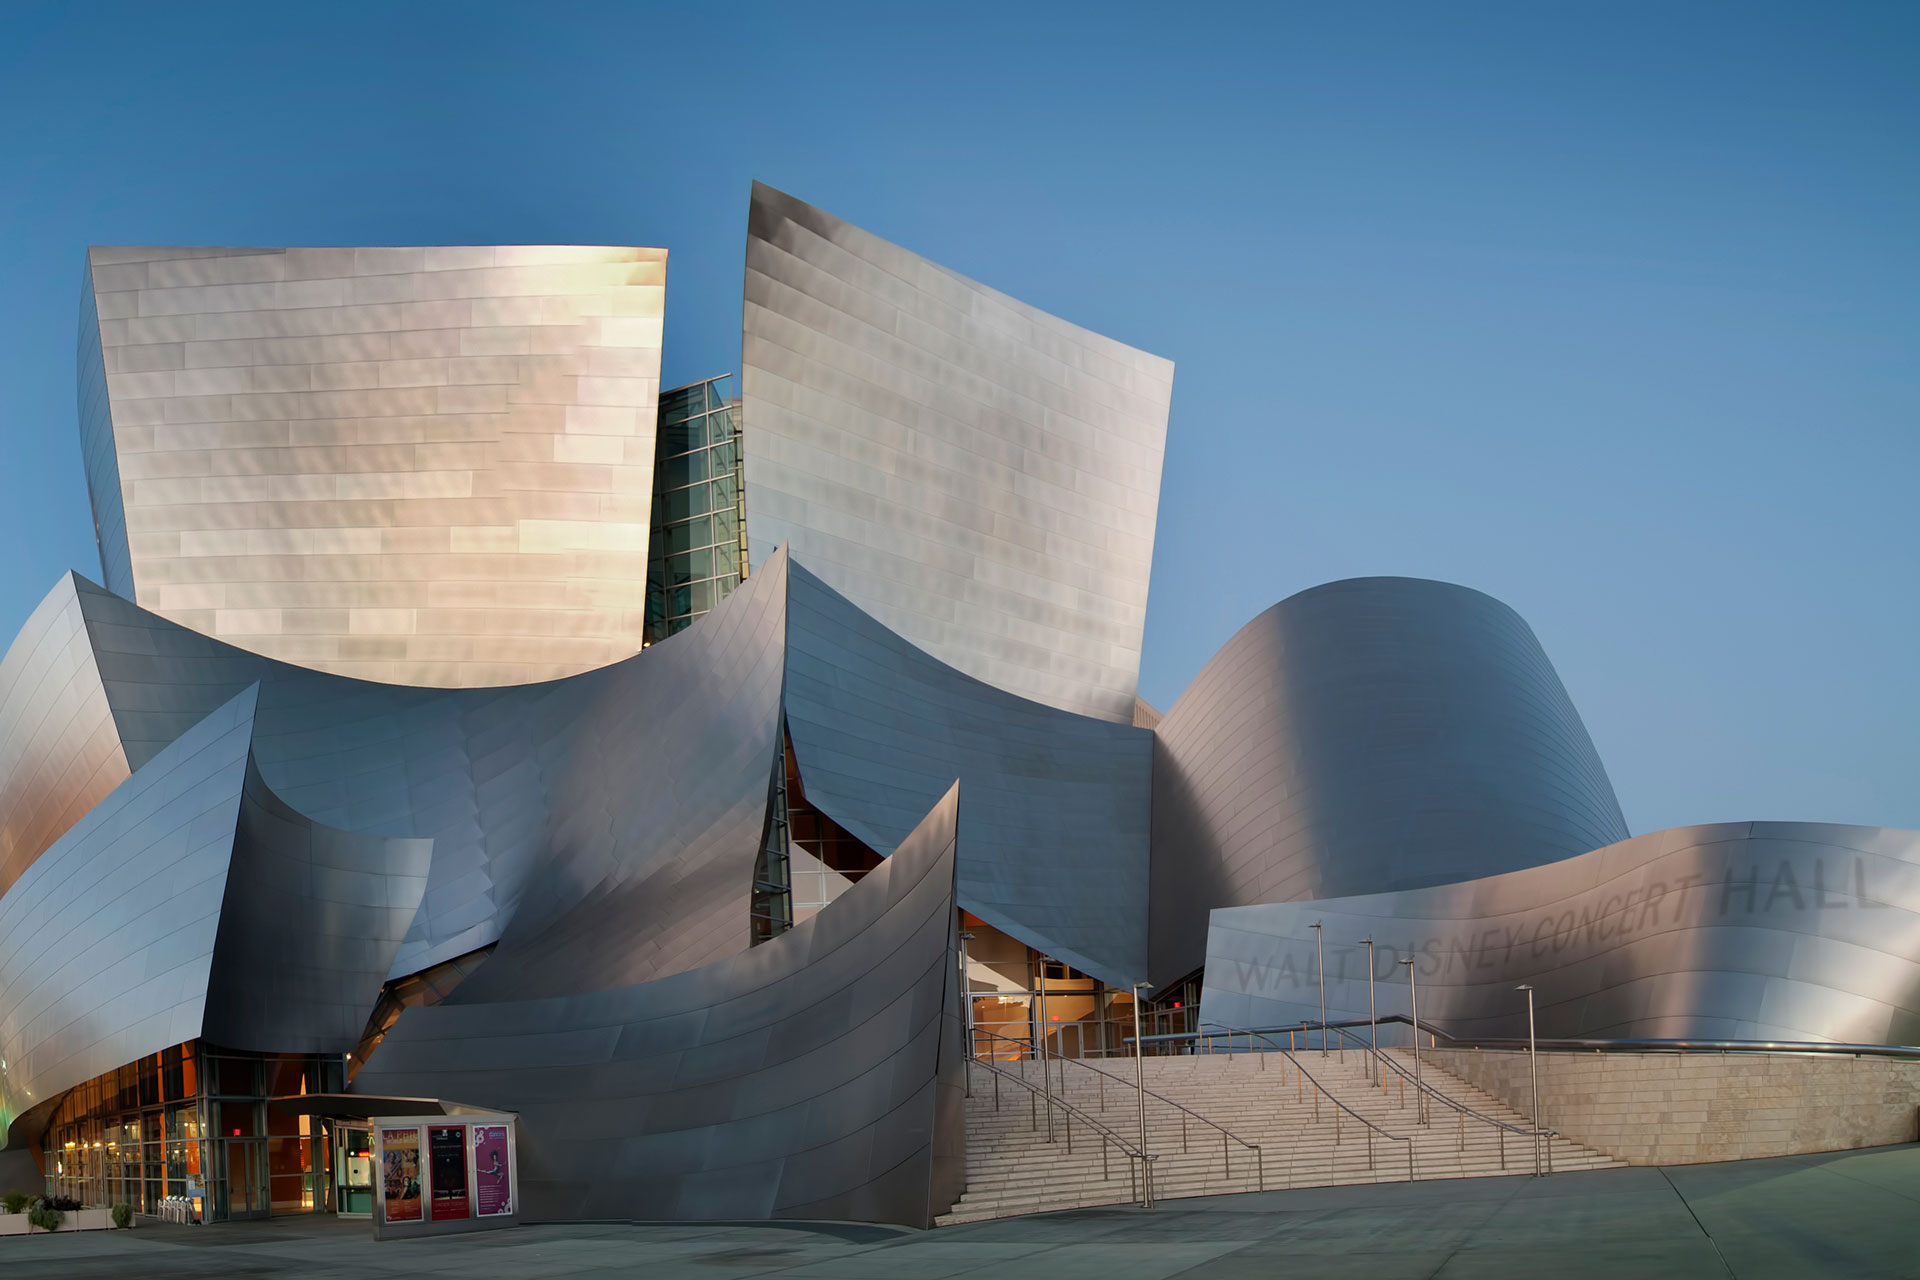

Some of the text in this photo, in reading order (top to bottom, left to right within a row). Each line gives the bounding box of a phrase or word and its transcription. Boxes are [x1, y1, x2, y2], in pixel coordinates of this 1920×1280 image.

[1235, 856, 1889, 991] WALT DISNEY CONCERT HALL
